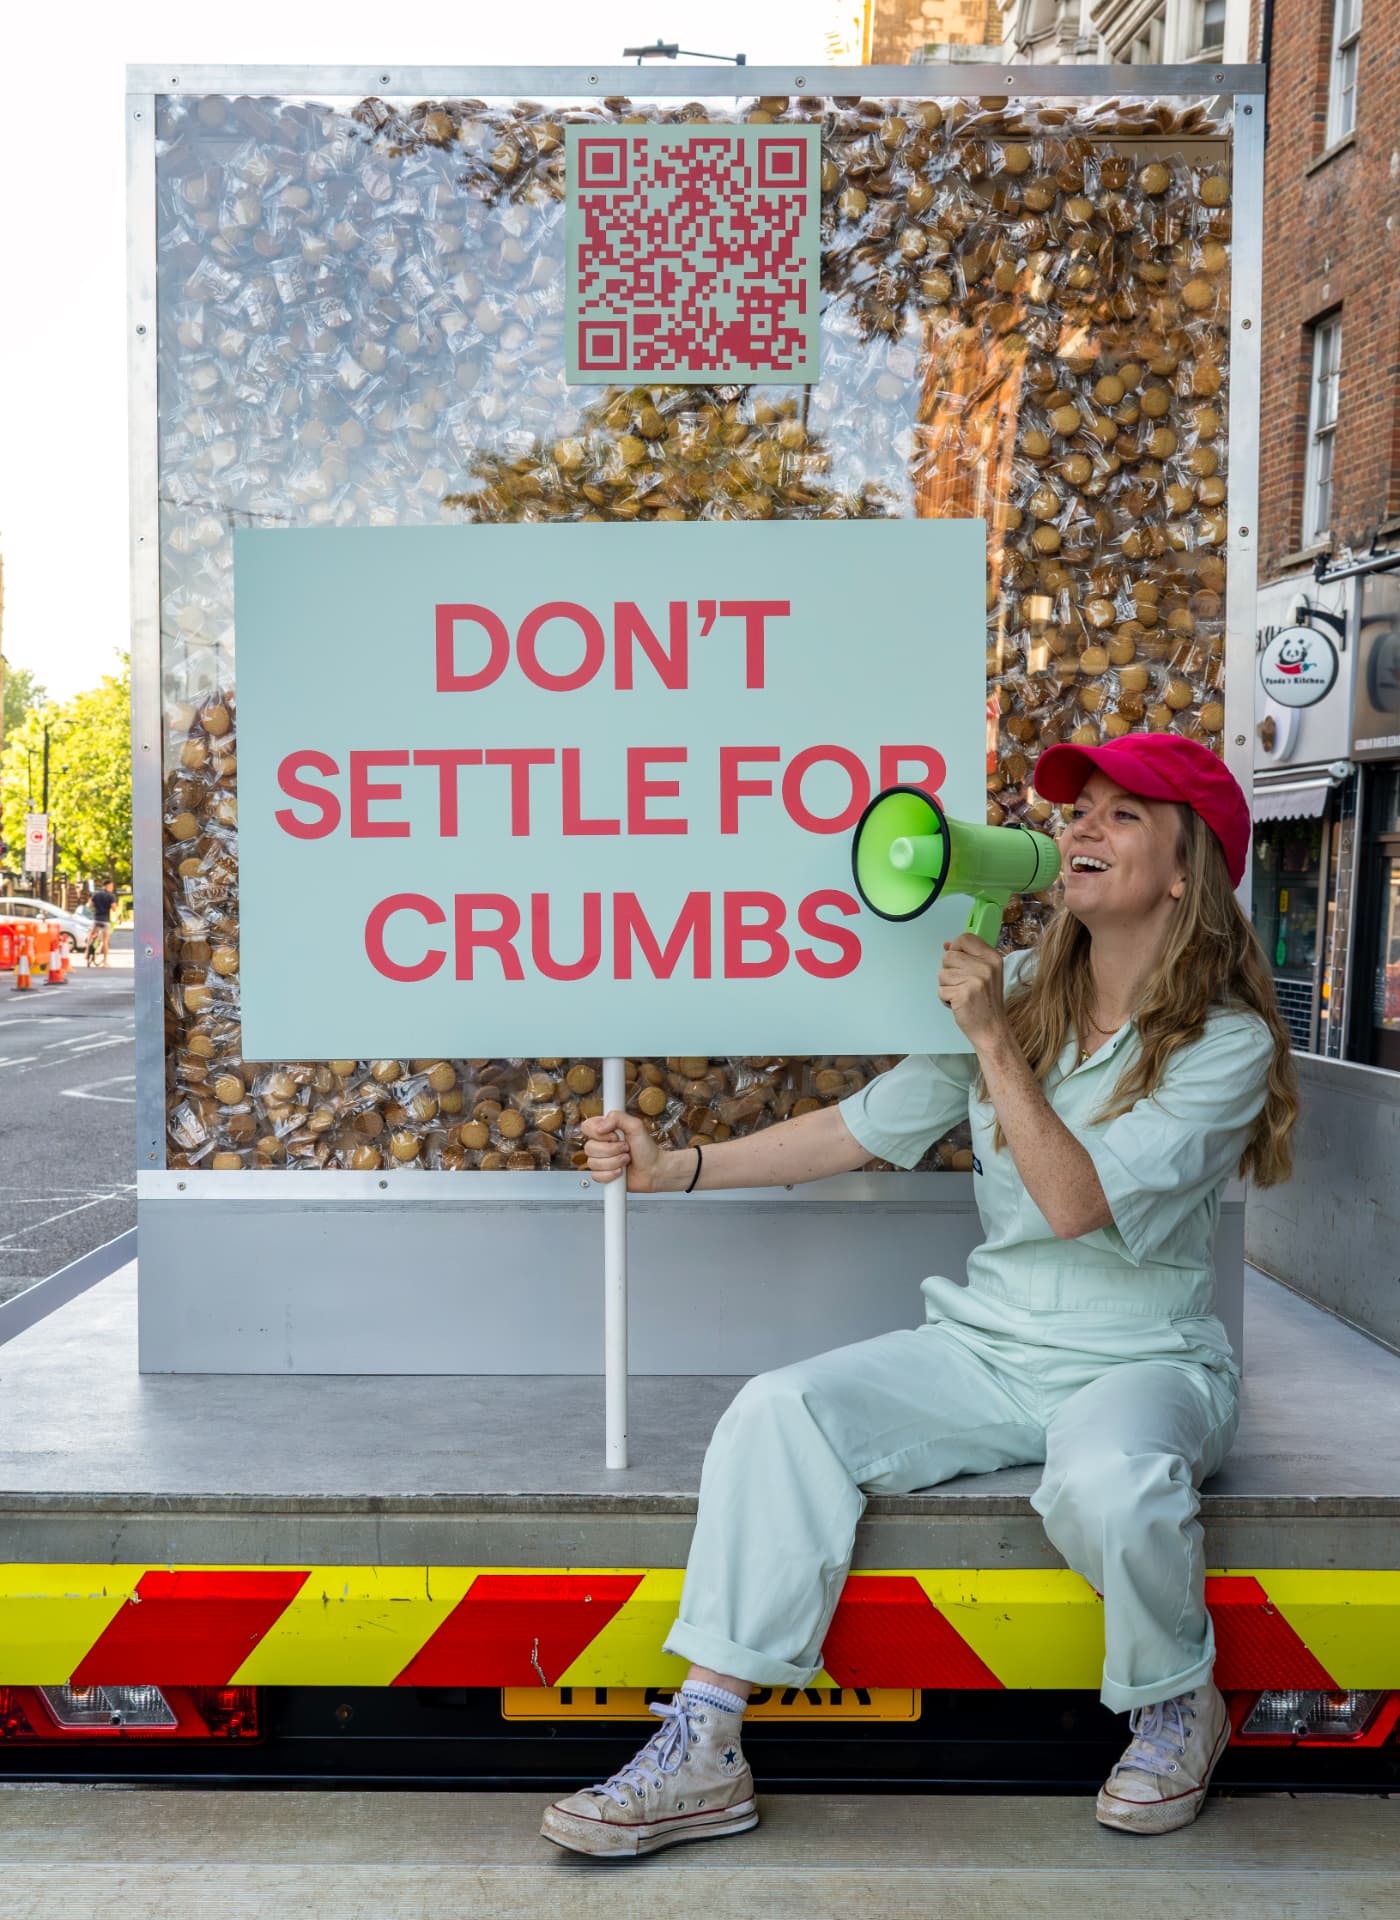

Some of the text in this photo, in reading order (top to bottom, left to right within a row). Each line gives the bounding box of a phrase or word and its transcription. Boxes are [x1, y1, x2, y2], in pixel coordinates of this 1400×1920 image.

[436, 600, 790, 692] DON'T
[1294, 677, 1325, 685] Kitchen
[276, 747, 687, 839] SETTLE
[365, 889, 862, 982] CRUMBS
